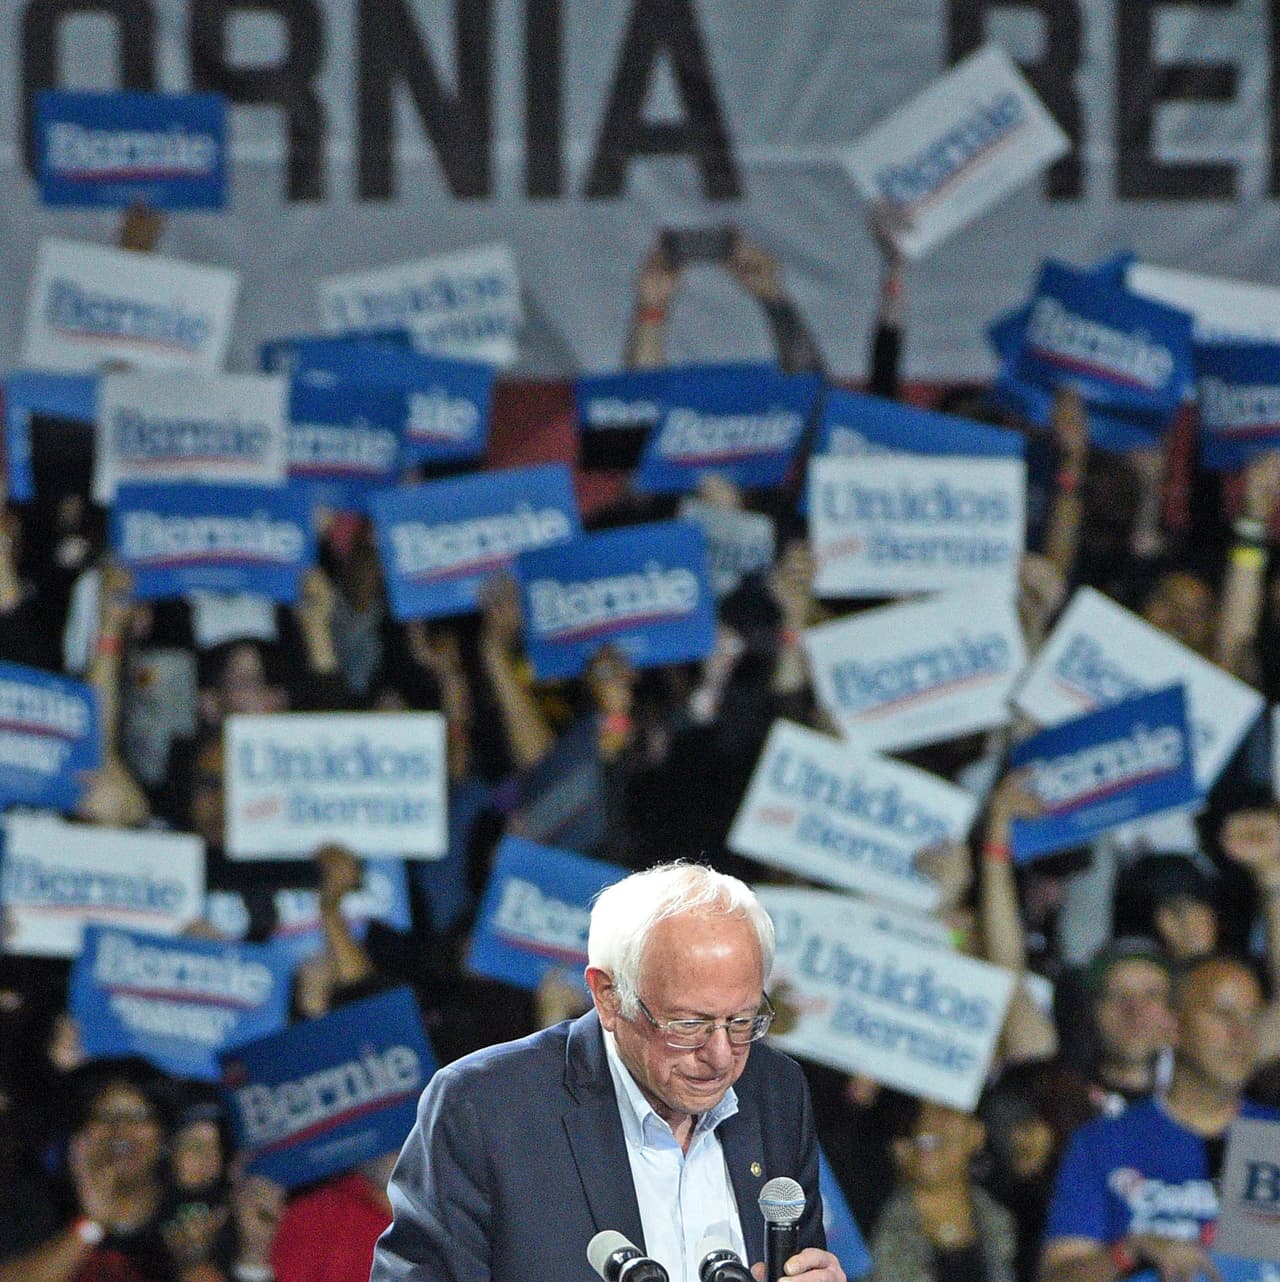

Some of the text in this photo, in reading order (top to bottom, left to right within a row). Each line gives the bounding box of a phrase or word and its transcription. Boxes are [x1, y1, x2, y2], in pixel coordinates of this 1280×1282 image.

[46, 118, 217, 170] Bernie
[876, 93, 1018, 203] Bernie
[48, 276, 210, 345] Bernie
[122, 405, 286, 460] Bernie
[824, 467, 1011, 523] Unidos
[122, 508, 304, 560] Bernie
[388, 500, 570, 573] Bernie
[526, 560, 701, 638] Bernie
[833, 620, 1009, 712] Bernie
[235, 737, 430, 783] Unidos
[770, 746, 955, 843] Unidos
[9, 846, 187, 908] Bernie
[94, 935, 274, 1006] Bernie
[797, 942, 993, 1031] Unidos
[237, 1040, 419, 1149] Bernie
